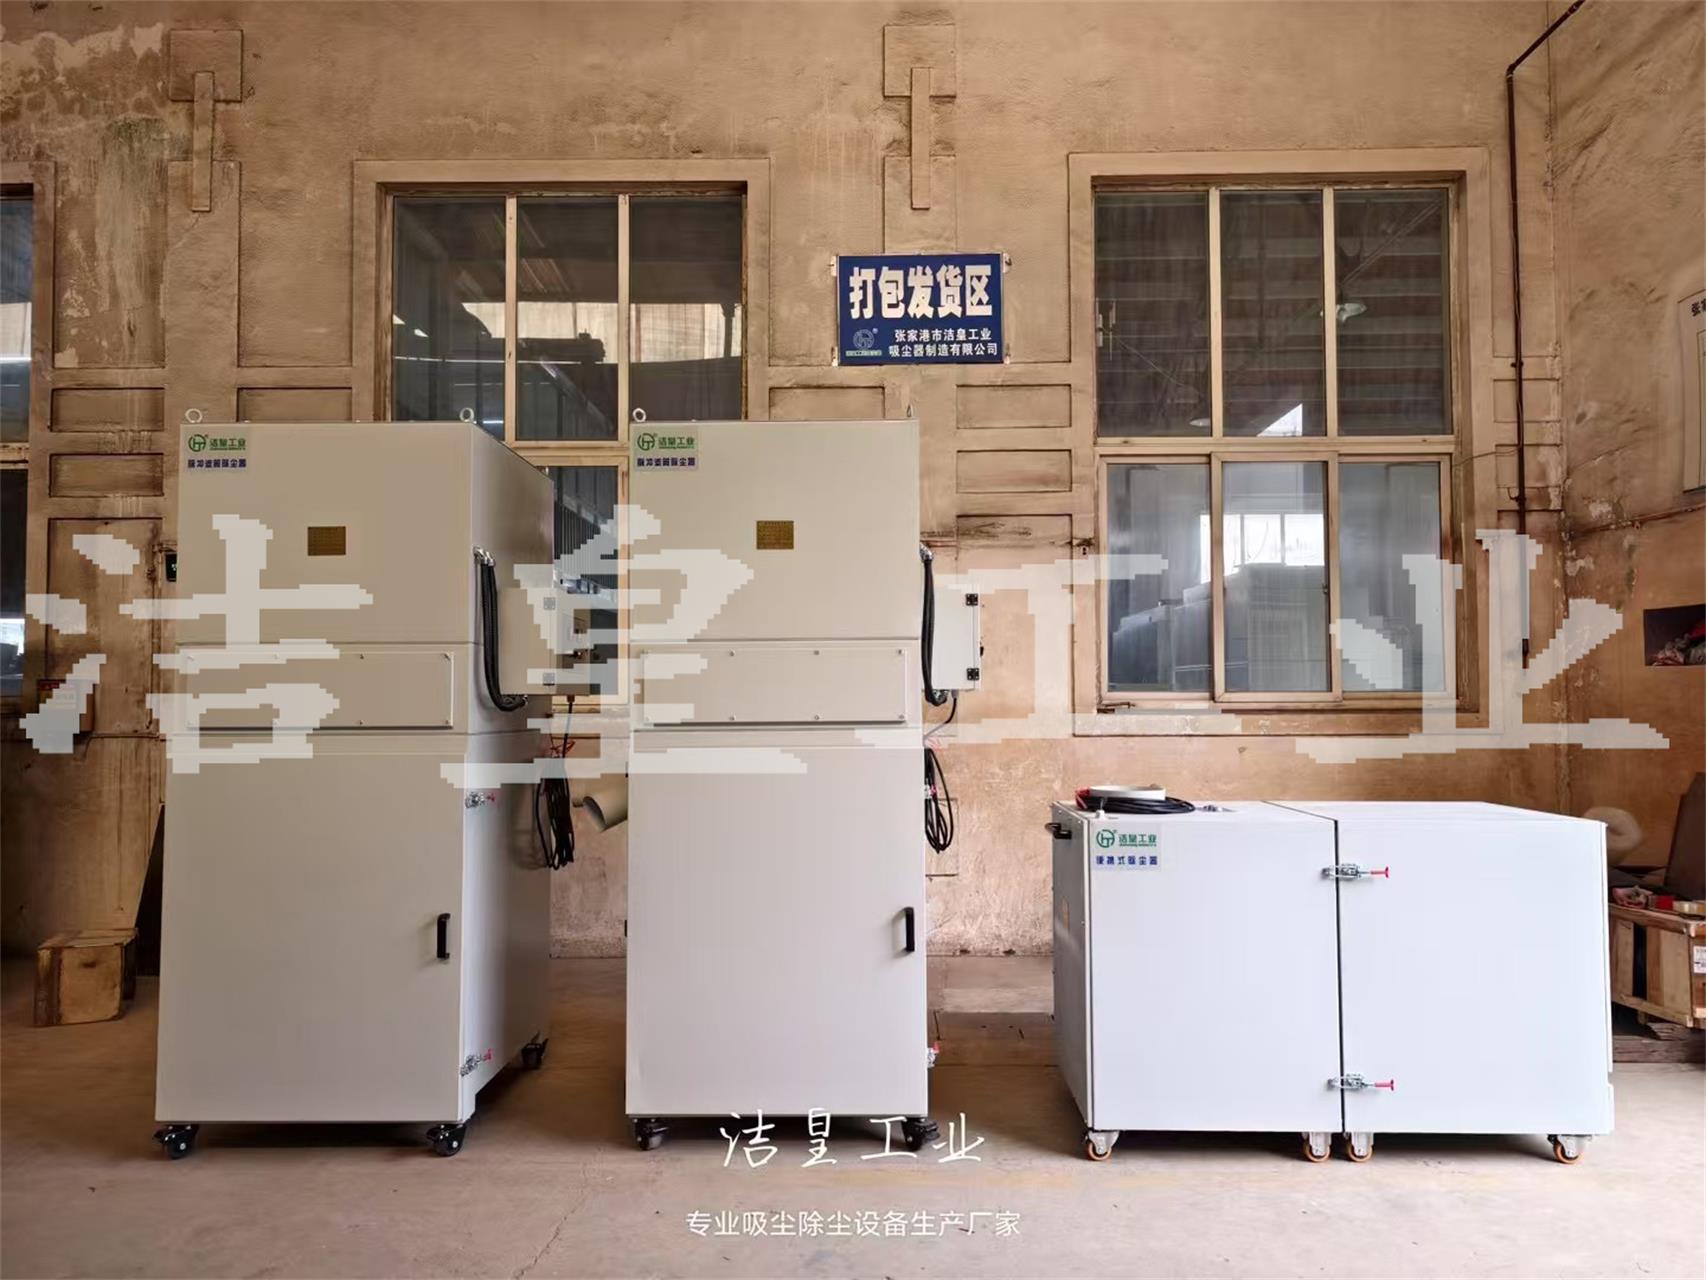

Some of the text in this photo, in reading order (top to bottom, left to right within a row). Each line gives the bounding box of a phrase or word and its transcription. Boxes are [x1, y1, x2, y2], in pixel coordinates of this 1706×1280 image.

[849, 264, 993, 319] 打包发货区
[894, 328, 992, 342] 张家港市洁皇工业
[888, 343, 998, 357] 吸尘器制造有限公司
